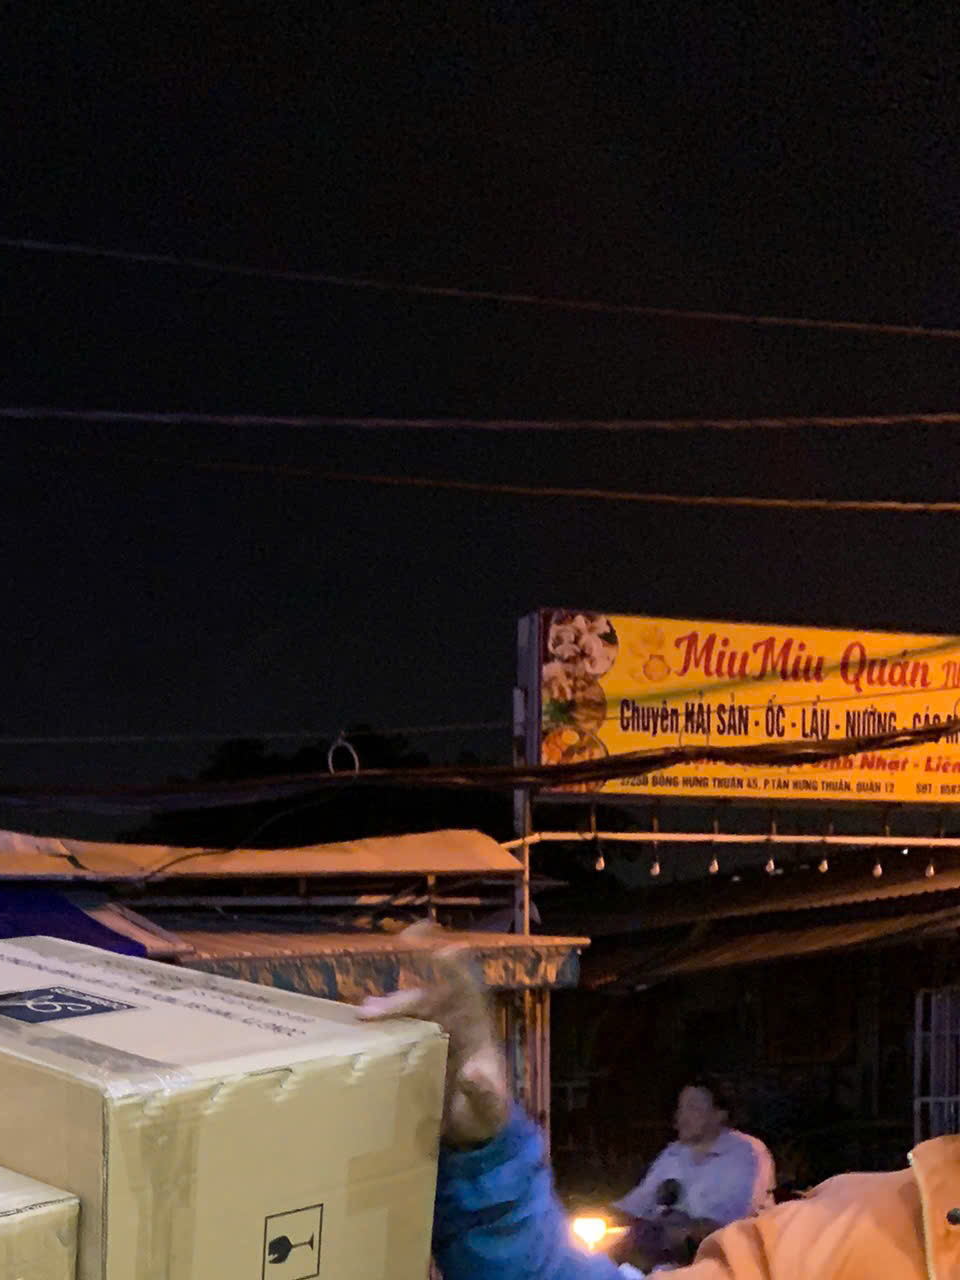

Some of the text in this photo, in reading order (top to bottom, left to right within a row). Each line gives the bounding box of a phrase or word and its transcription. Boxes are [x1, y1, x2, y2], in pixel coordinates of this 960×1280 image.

[619, 698, 680, 737] Chuyên
[684, 689, 711, 735] HẢI
[716, 691, 750, 736] SẢN
[765, 693, 786, 738] ỐC
[801, 694, 830, 741] LẨU
